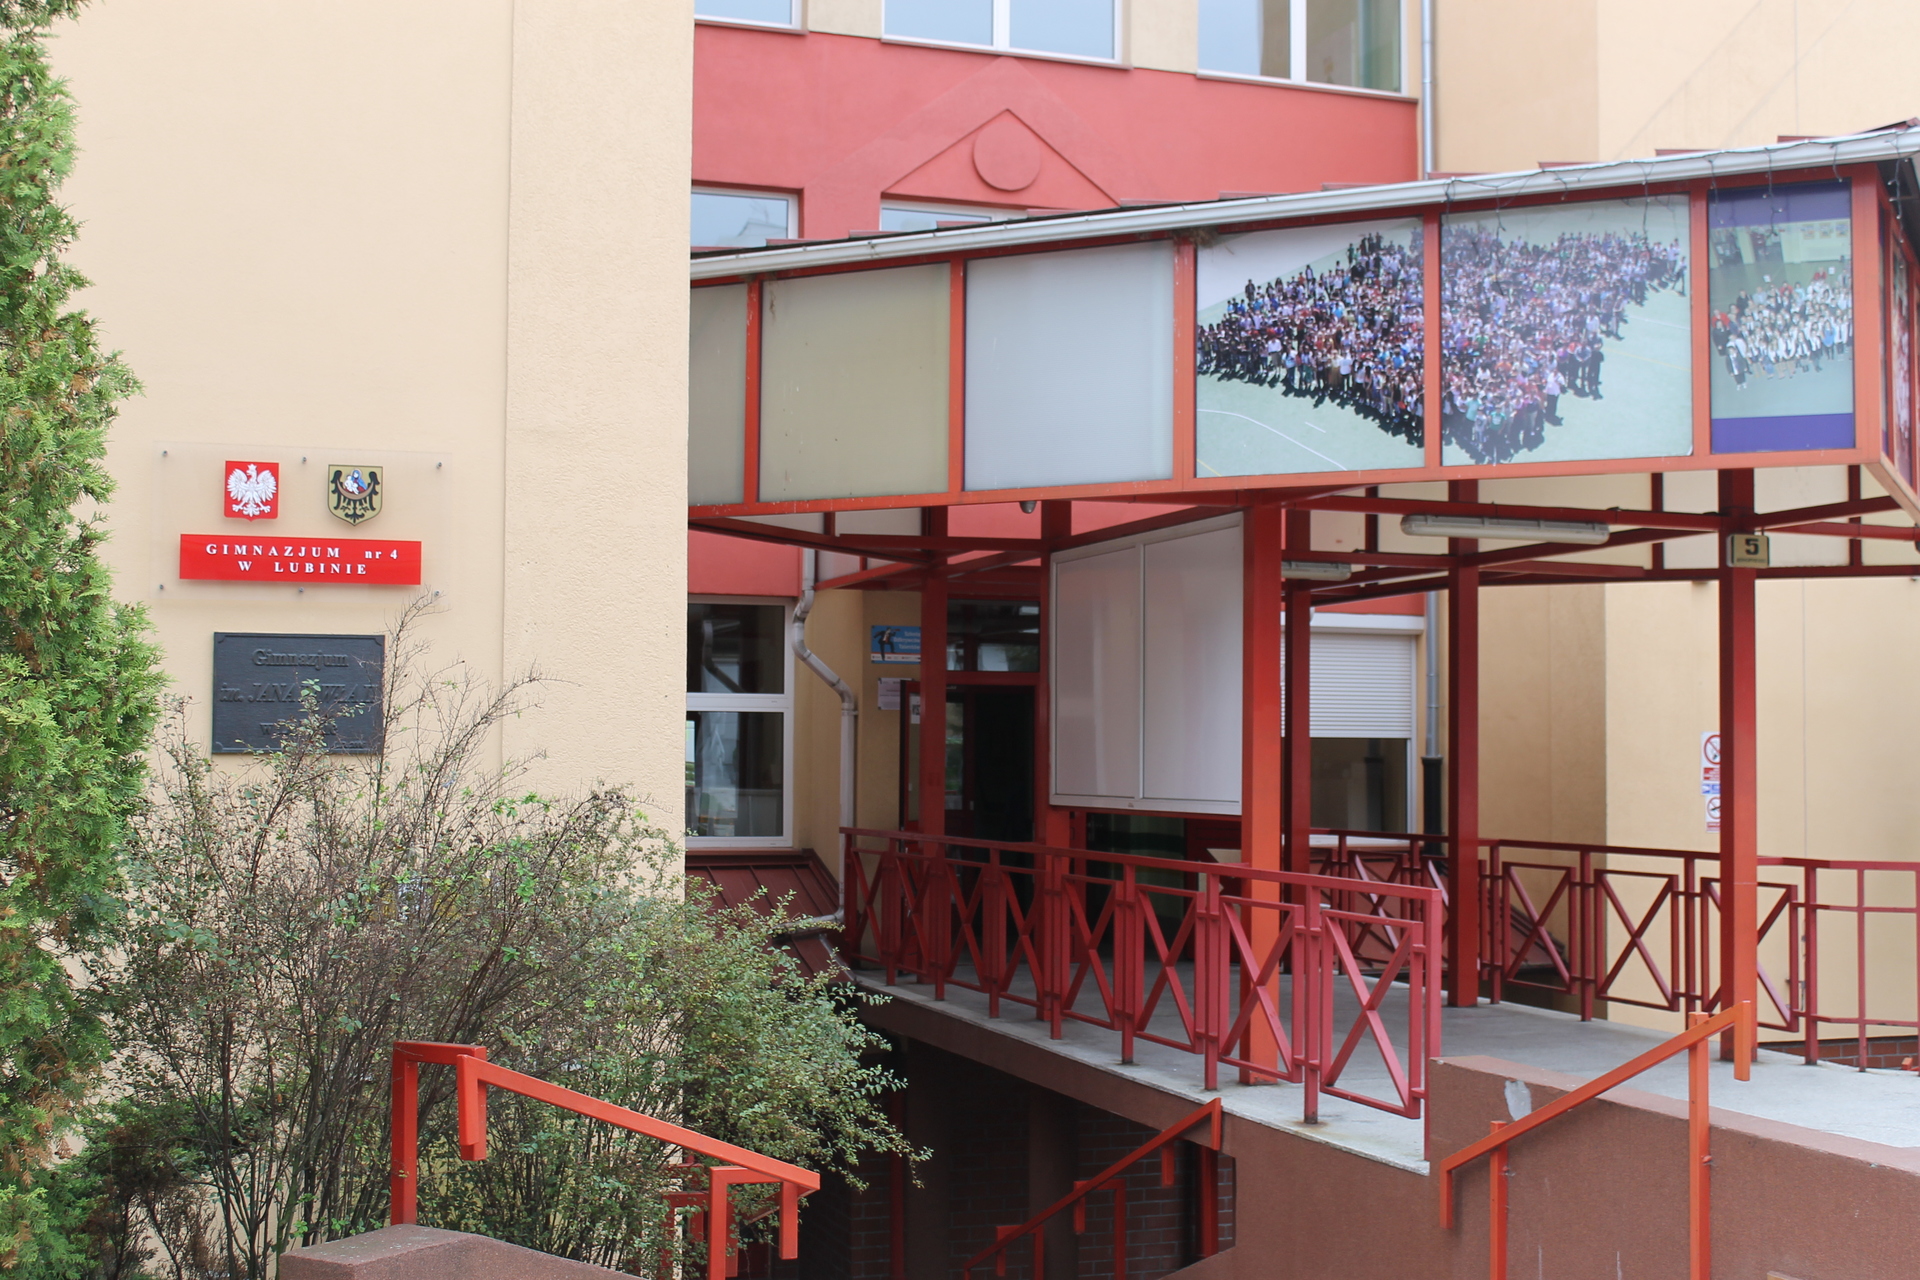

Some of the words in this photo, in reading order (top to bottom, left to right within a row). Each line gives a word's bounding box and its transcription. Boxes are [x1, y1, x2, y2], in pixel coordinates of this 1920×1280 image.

[206, 543, 341, 559] GIMNAZJUM
[364, 550, 382, 559] nr
[389, 549, 399, 560] 4
[1744, 537, 1759, 555] 5
[237, 560, 253, 573] W
[274, 561, 367, 575] LUBINIE
[252, 648, 350, 671] Gimnazjum
[219, 682, 243, 703] im.
[247, 682, 296, 703] JANA
